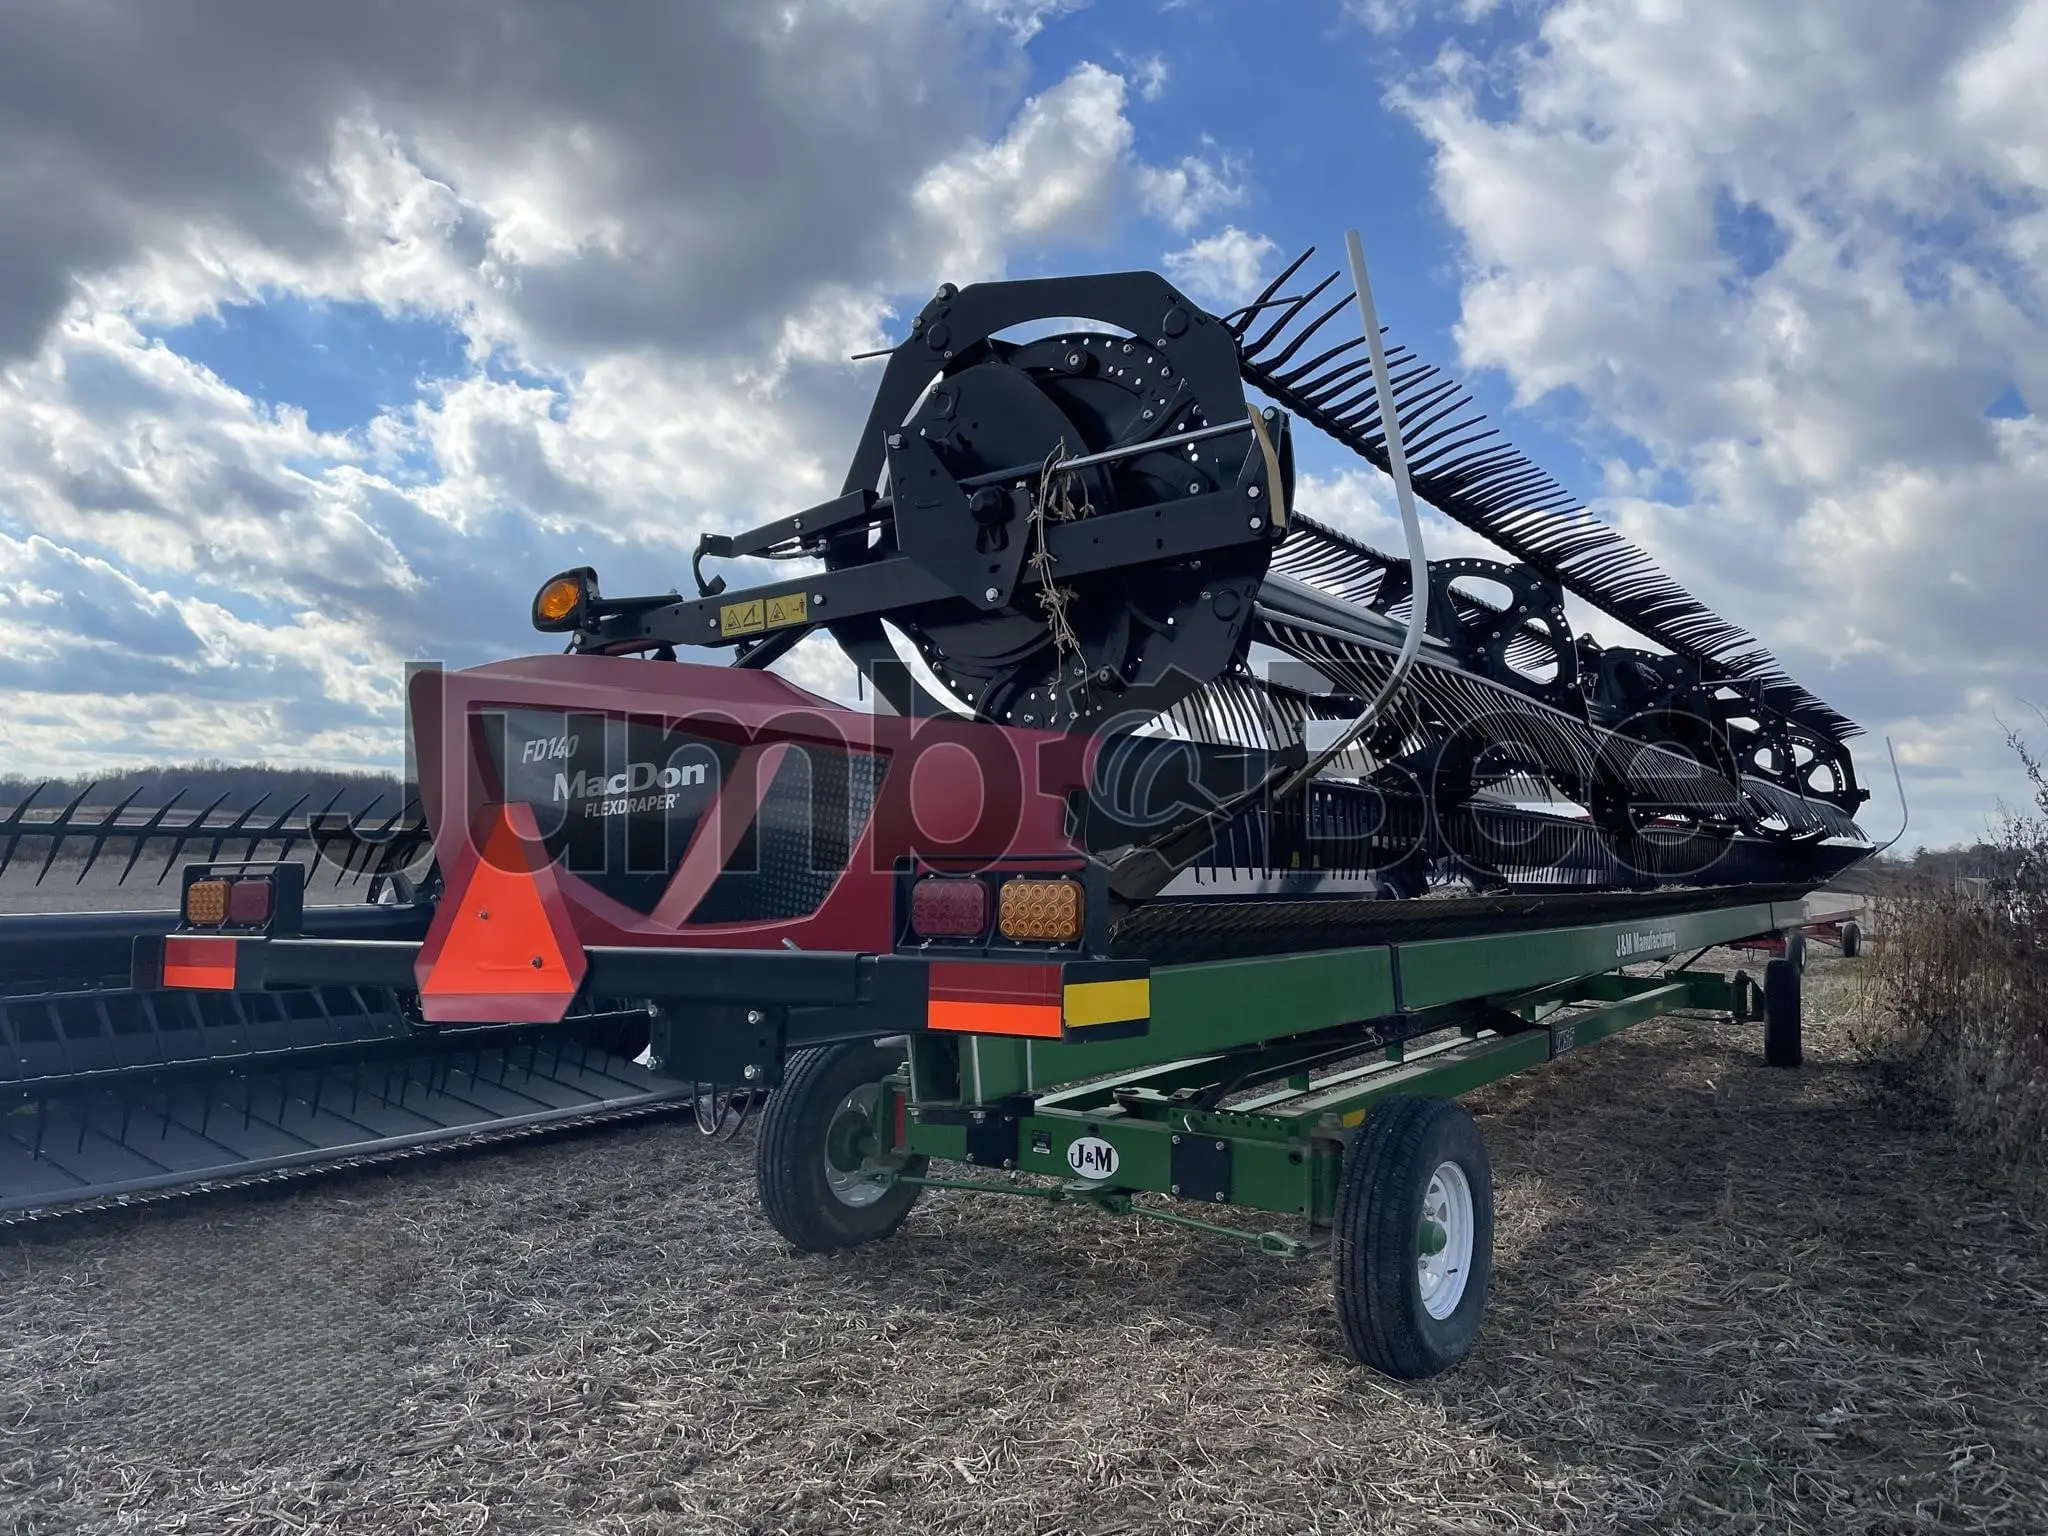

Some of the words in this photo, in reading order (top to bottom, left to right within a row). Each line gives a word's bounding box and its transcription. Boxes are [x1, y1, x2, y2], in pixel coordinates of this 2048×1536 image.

[522, 735, 579, 764] FD140
[552, 762, 706, 802] MacDon
[584, 793, 677, 819] FLEXDRAPER
[1616, 933, 1633, 958] J&M
[1633, 927, 1676, 952] Manufacturing
[1070, 1143, 1113, 1173] J&M
